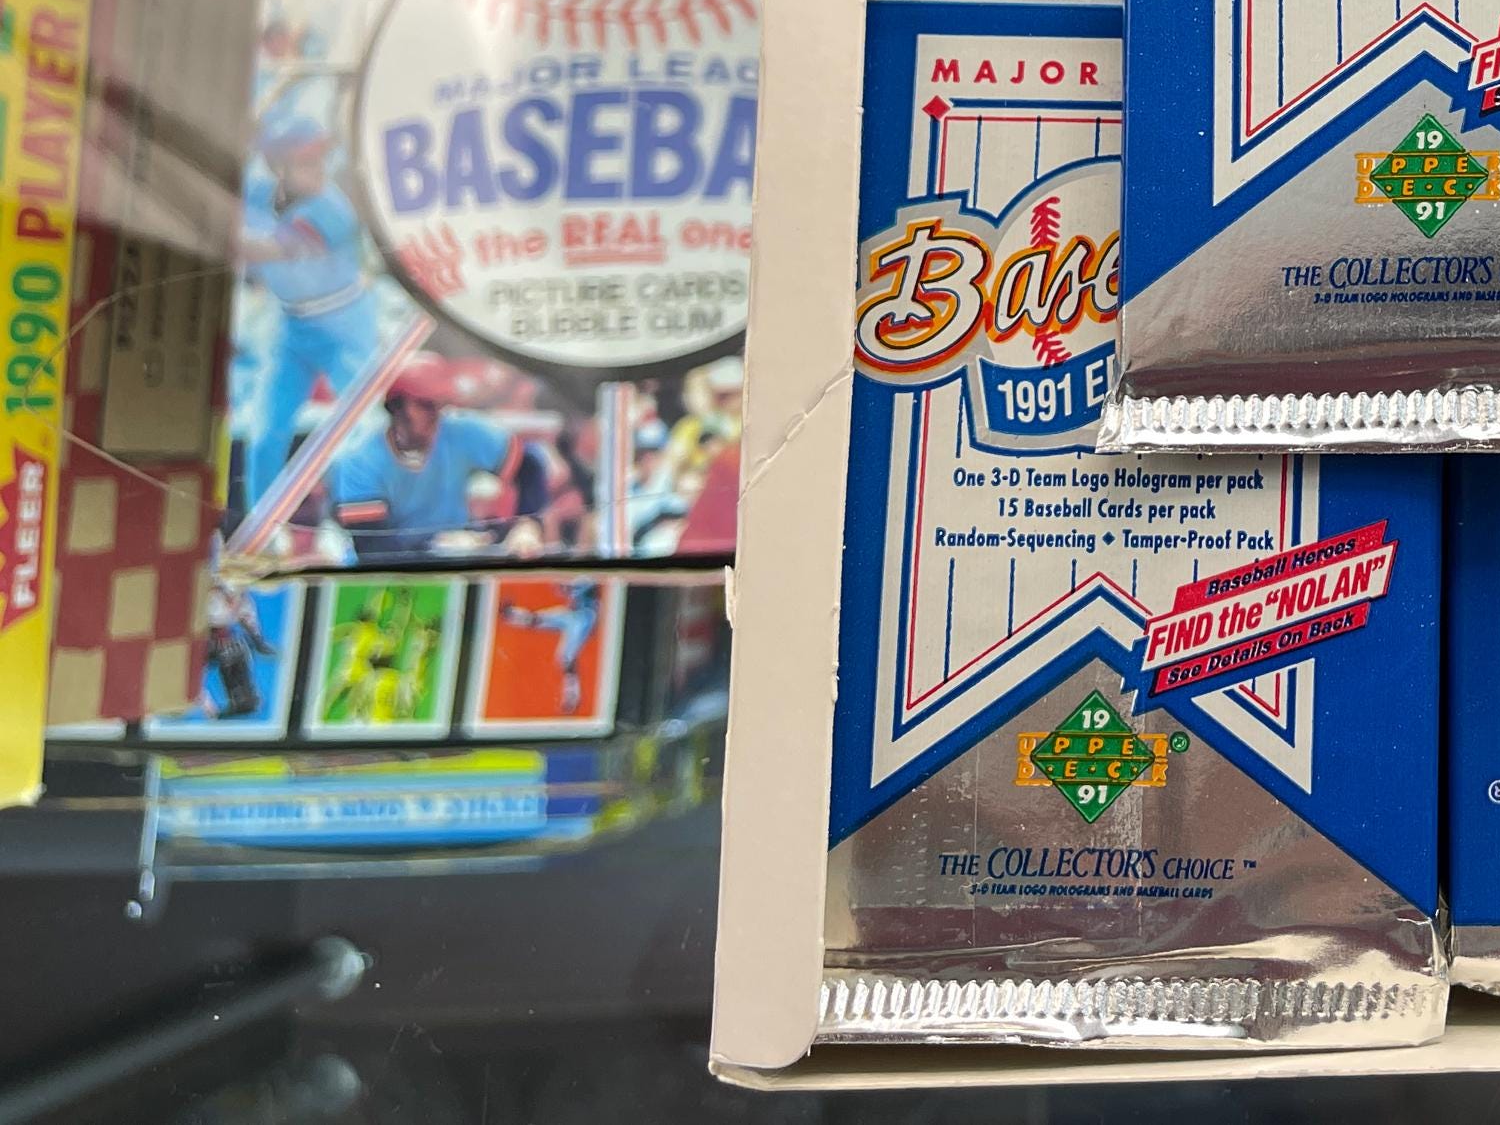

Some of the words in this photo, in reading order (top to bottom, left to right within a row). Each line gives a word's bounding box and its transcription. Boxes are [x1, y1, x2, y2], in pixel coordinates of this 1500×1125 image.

[931, 59, 1098, 86] MAJOR
[18, 5, 80, 243] PLAYER
[1416, 130, 1443, 150] 19
[384, 88, 757, 217] BASEBA
[1416, 201, 1445, 221] 91
[560, 211, 666, 248] REAL
[1282, 265, 1322, 287] THE
[1329, 255, 1494, 289] COLLECTOR'S
[855, 217, 1120, 373] Base
[1333, 292, 1360, 304] TEAM
[1361, 292, 1388, 304] LOGO
[1390, 291, 1449, 303] HOLOGRAMS
[1452, 291, 1472, 302] AND
[6, 259, 63, 416] 1990
[998, 373, 1072, 422] 1991
[953, 467, 985, 487] One
[990, 467, 1021, 487] 3-D
[1026, 467, 1066, 487] Team
[1071, 467, 1109, 490] Logo
[1114, 467, 1193, 492] Hologram
[1196, 474, 1222, 492] per
[1226, 471, 1264, 492] pack
[999, 499, 1021, 517] 15
[1024, 498, 1092, 518] Baseball
[1098, 500, 1142, 518] Cards
[1148, 504, 1175, 521] per
[1179, 499, 1216, 521] pack
[12, 458, 46, 610] FLEER
[935, 527, 1096, 551] Random-Sequencing
[1122, 531, 1232, 554] Tamper-Proof
[1237, 531, 1274, 550] Pack
[1207, 557, 1287, 597] Baseball
[1292, 536, 1356, 568] Heroes
[1147, 620, 1213, 662] FIND
[1219, 601, 1262, 639] the
[1168, 665, 1201, 686] See
[1207, 638, 1271, 675] Details
[1278, 628, 1302, 649] On
[1308, 611, 1355, 637] Back
[1082, 709, 1110, 729] 19
[1018, 737, 1169, 756] UPPER
[1077, 784, 1108, 805] 91
[939, 853, 980, 876] THE
[987, 846, 1158, 880] COLLECTOR'S
[1163, 858, 1235, 881] CHOICE
[1019, 884, 1046, 897] LOGO
[1049, 884, 1110, 898] HOLOGRAMS
[1113, 885, 1134, 897] AND
[1137, 886, 1179, 898] BASEBALL
[1182, 887, 1213, 899] CARDS
